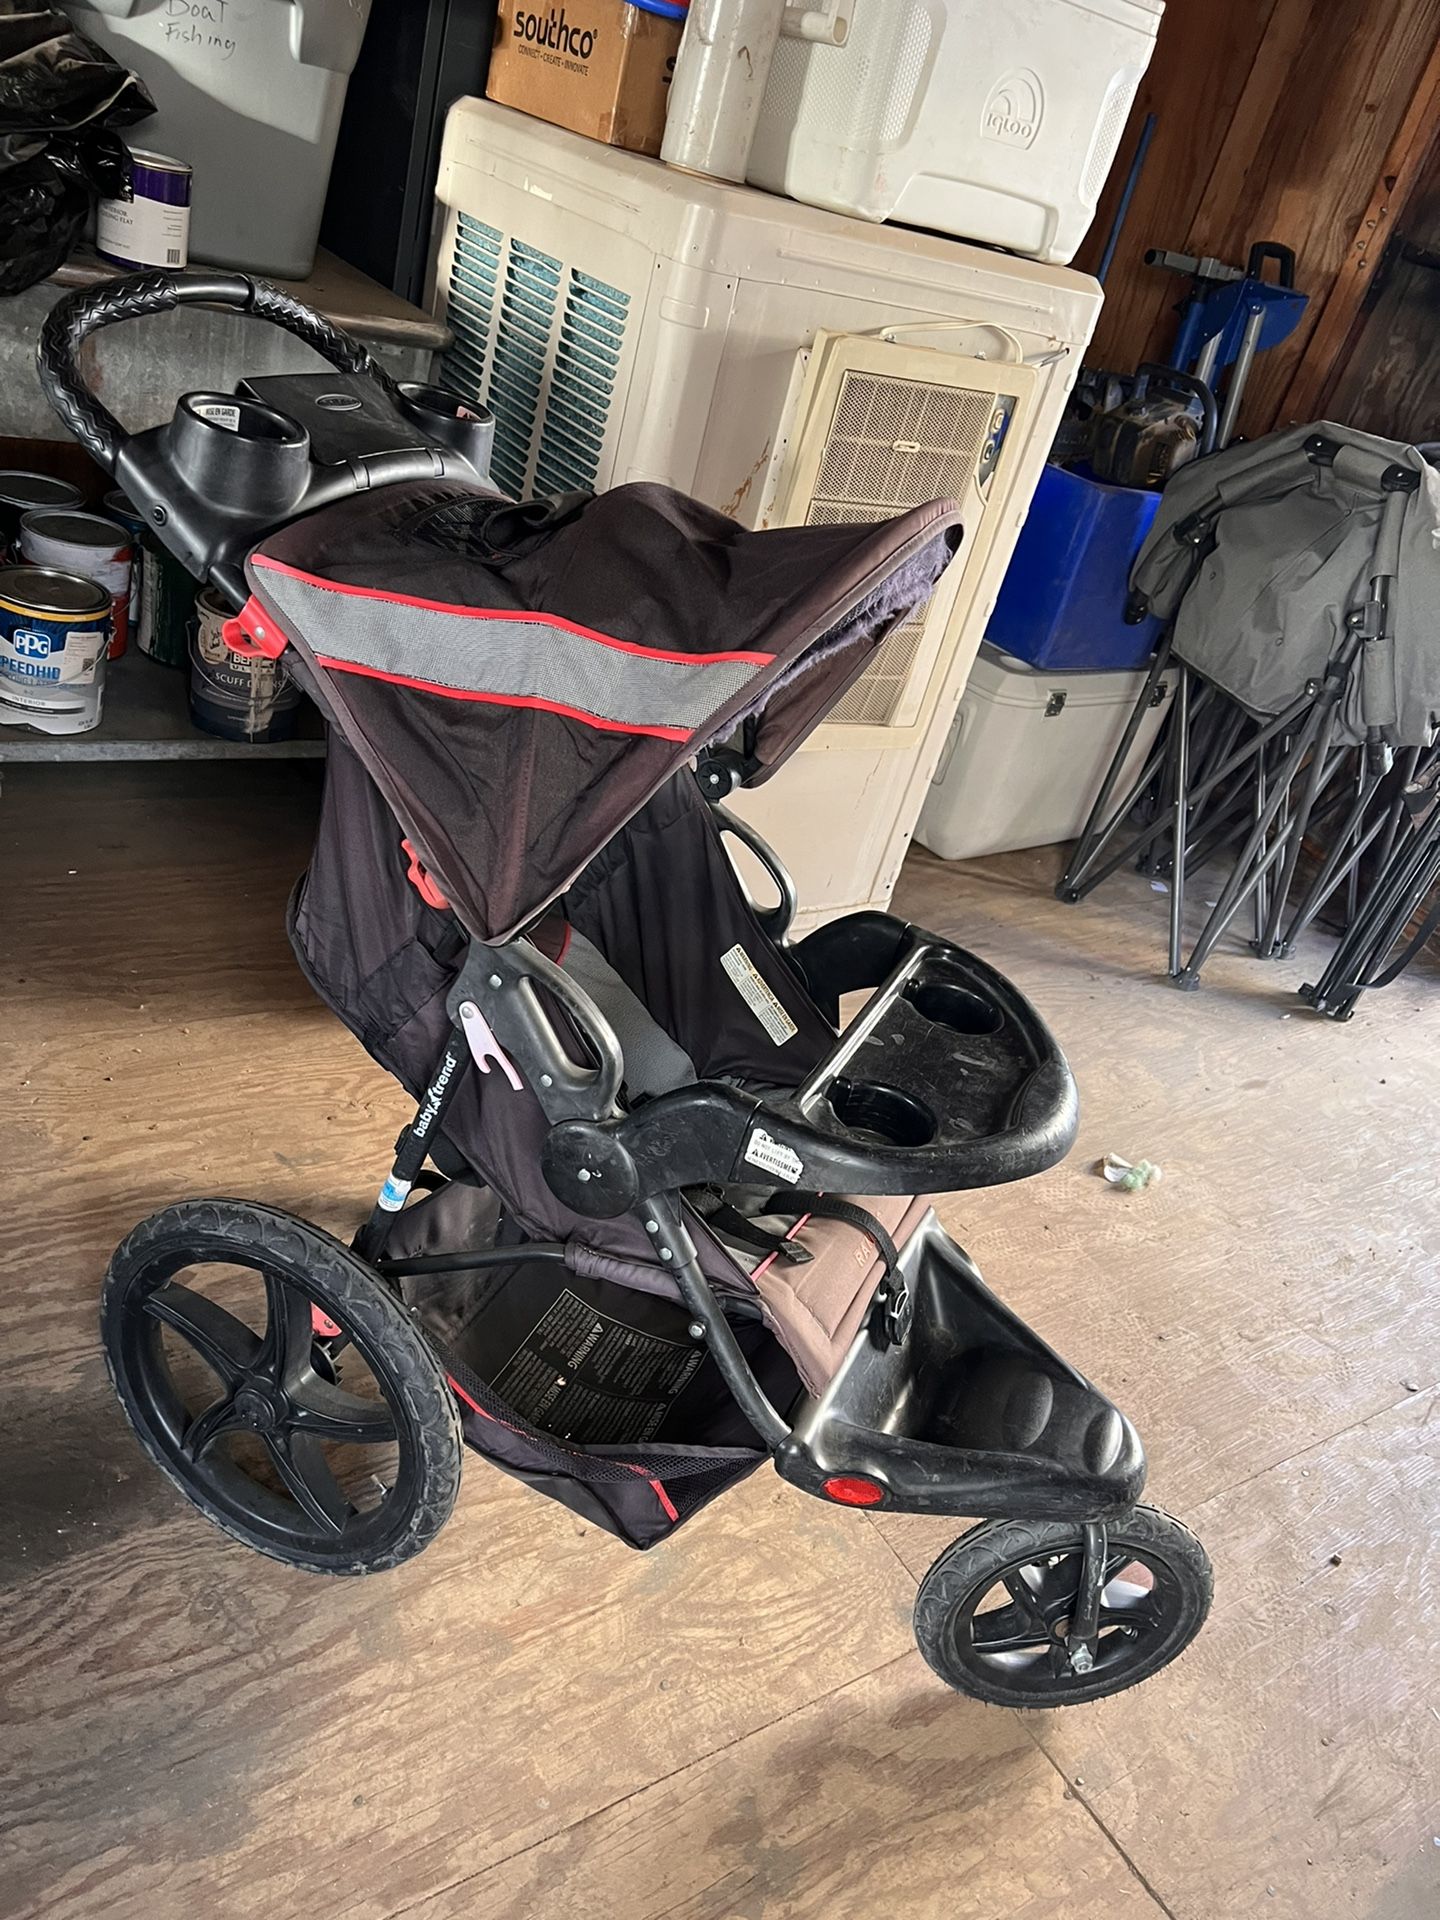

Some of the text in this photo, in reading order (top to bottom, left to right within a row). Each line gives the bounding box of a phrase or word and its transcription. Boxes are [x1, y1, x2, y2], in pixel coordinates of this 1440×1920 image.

[165, 22, 236, 61] Fishing
[513, 8, 594, 59] southco
[518, 44, 590, 77] CONNECT CREATE INNOVATE
[16, 634, 48, 655] PPG
[0, 656, 61, 681] PEEDHID
[215, 672, 243, 686] SCUFF
[11, 696, 46, 706] INTERIOR
[414, 1053, 457, 1138] baby trend
[568, 1332, 600, 1370] WARNING
[668, 1359, 700, 1395] WARNING
